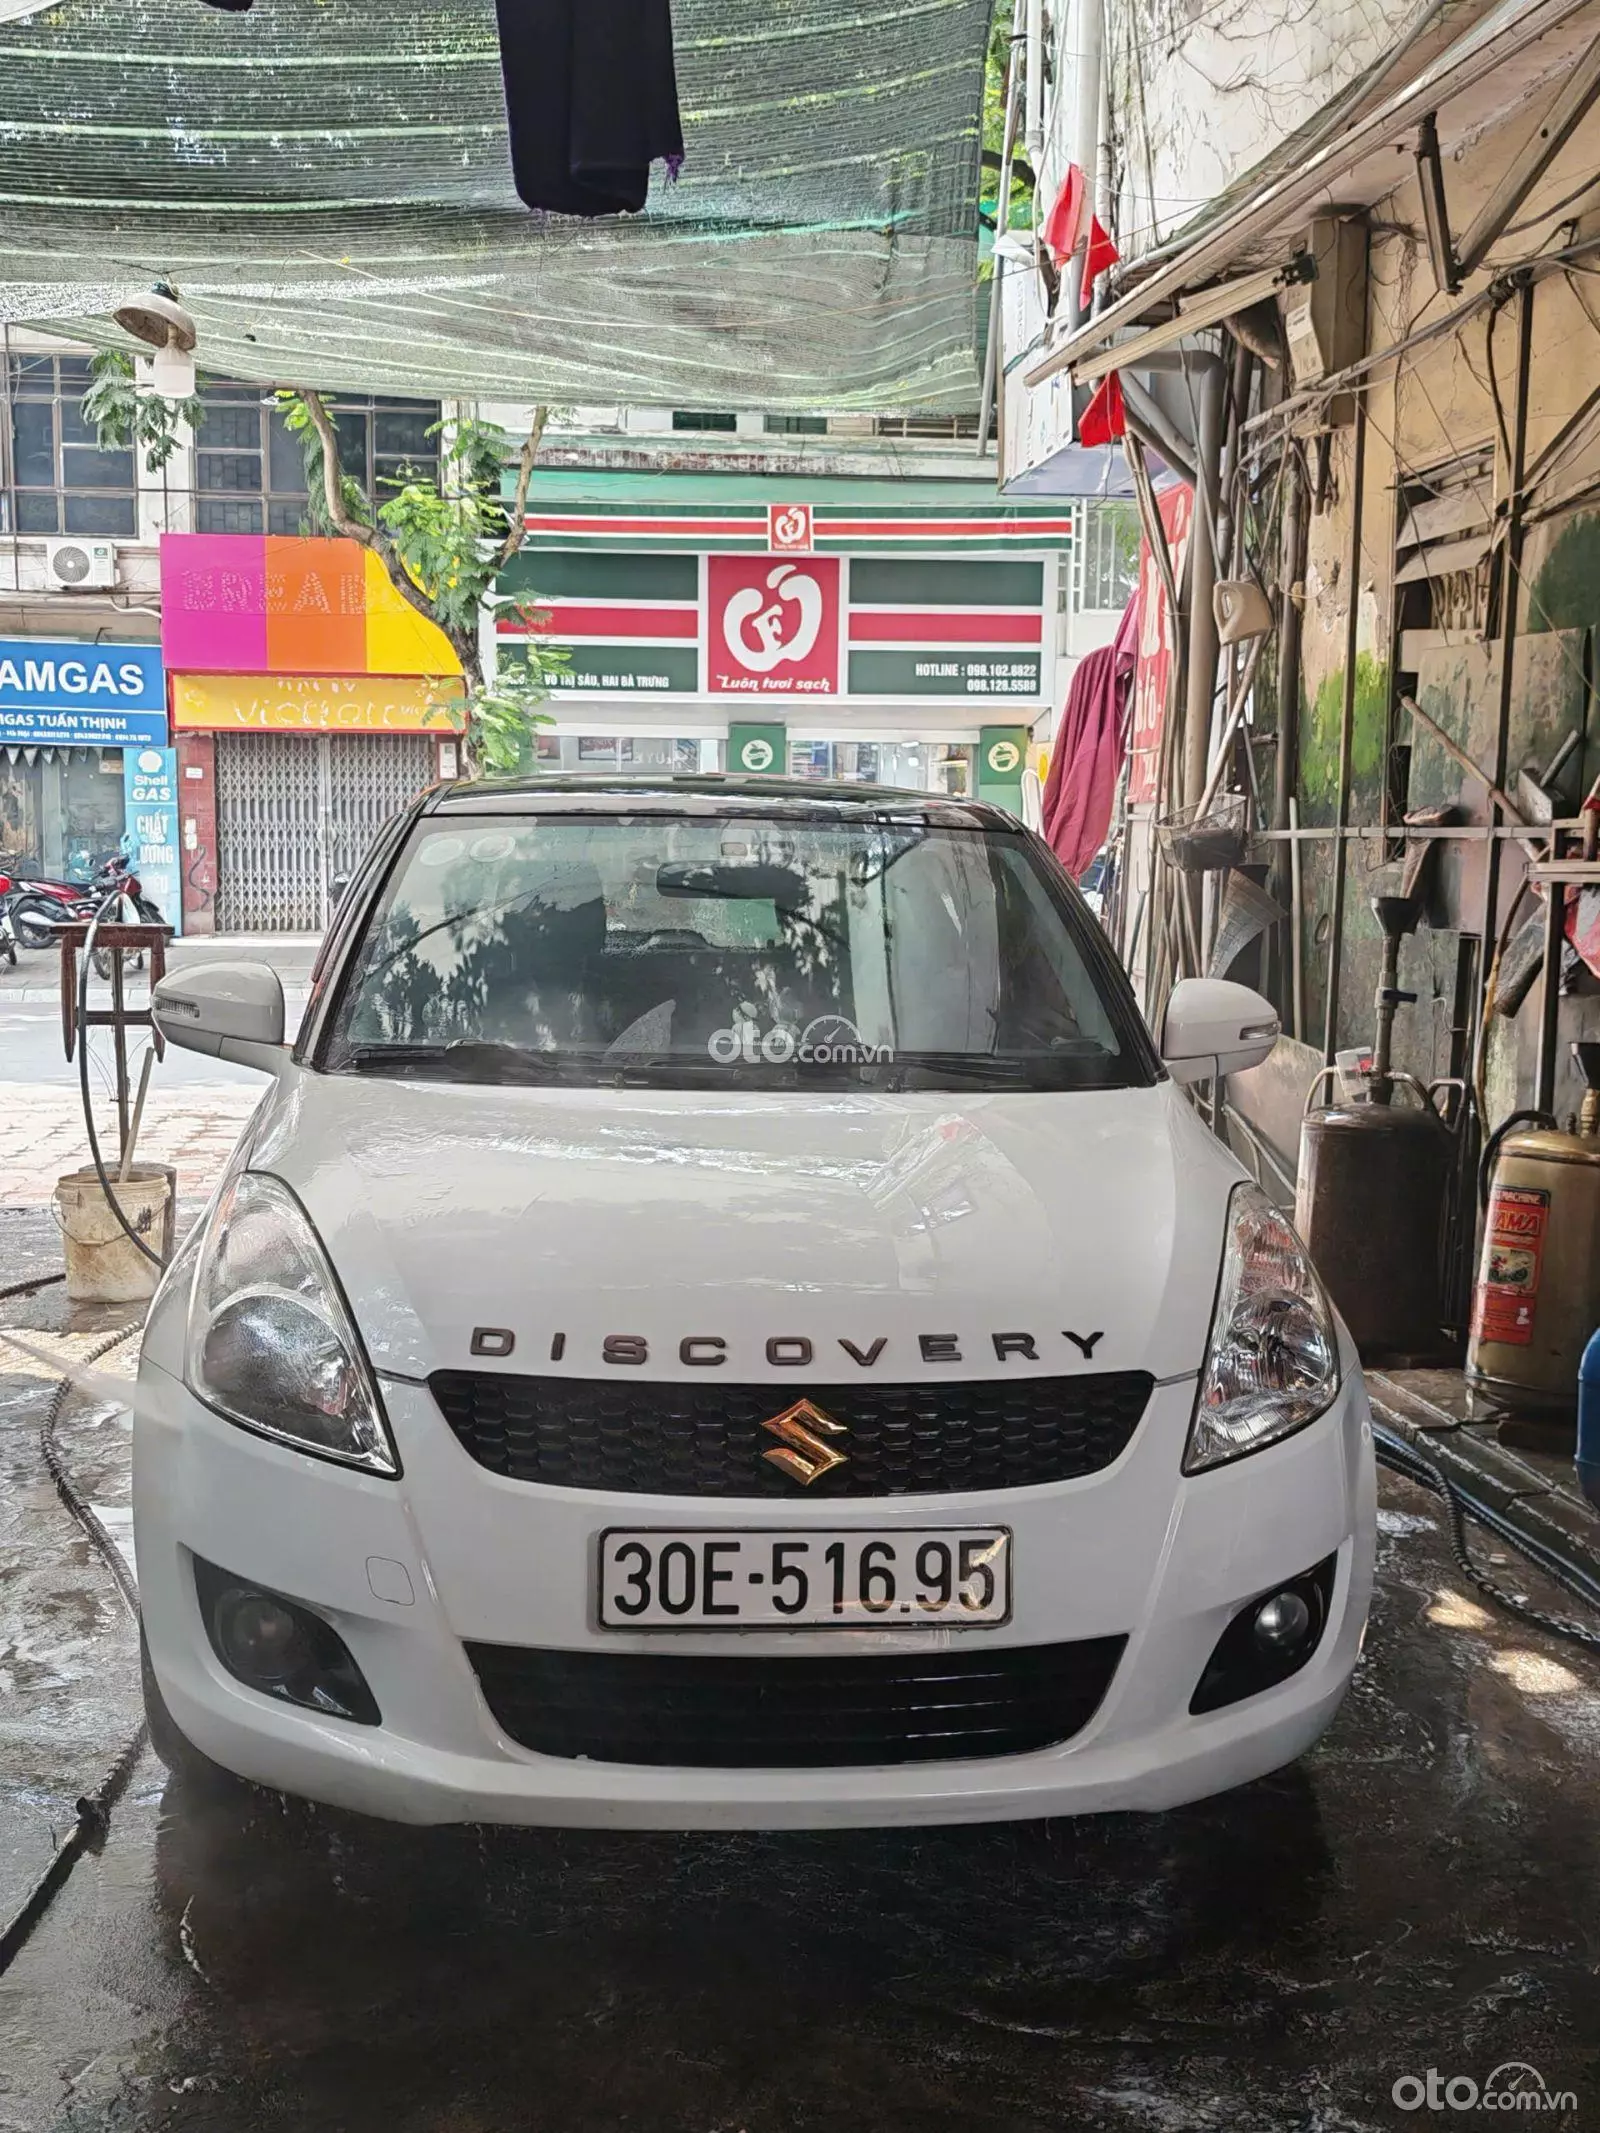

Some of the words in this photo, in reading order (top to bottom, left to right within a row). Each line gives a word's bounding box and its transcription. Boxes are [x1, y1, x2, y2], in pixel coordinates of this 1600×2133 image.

[915, 663, 959, 676] HOTLINE
[602, 674, 619, 687] HAI
[620, 672, 635, 687] BÀ
[636, 674, 670, 688] TRƯNG
[80, 716, 127, 732] THỊNH
[134, 774, 168, 786] Shell
[132, 787, 171, 801] GAS
[470, 1326, 1104, 1367] DISCOVERY
[612, 1539, 997, 1617] 30E-516.95
